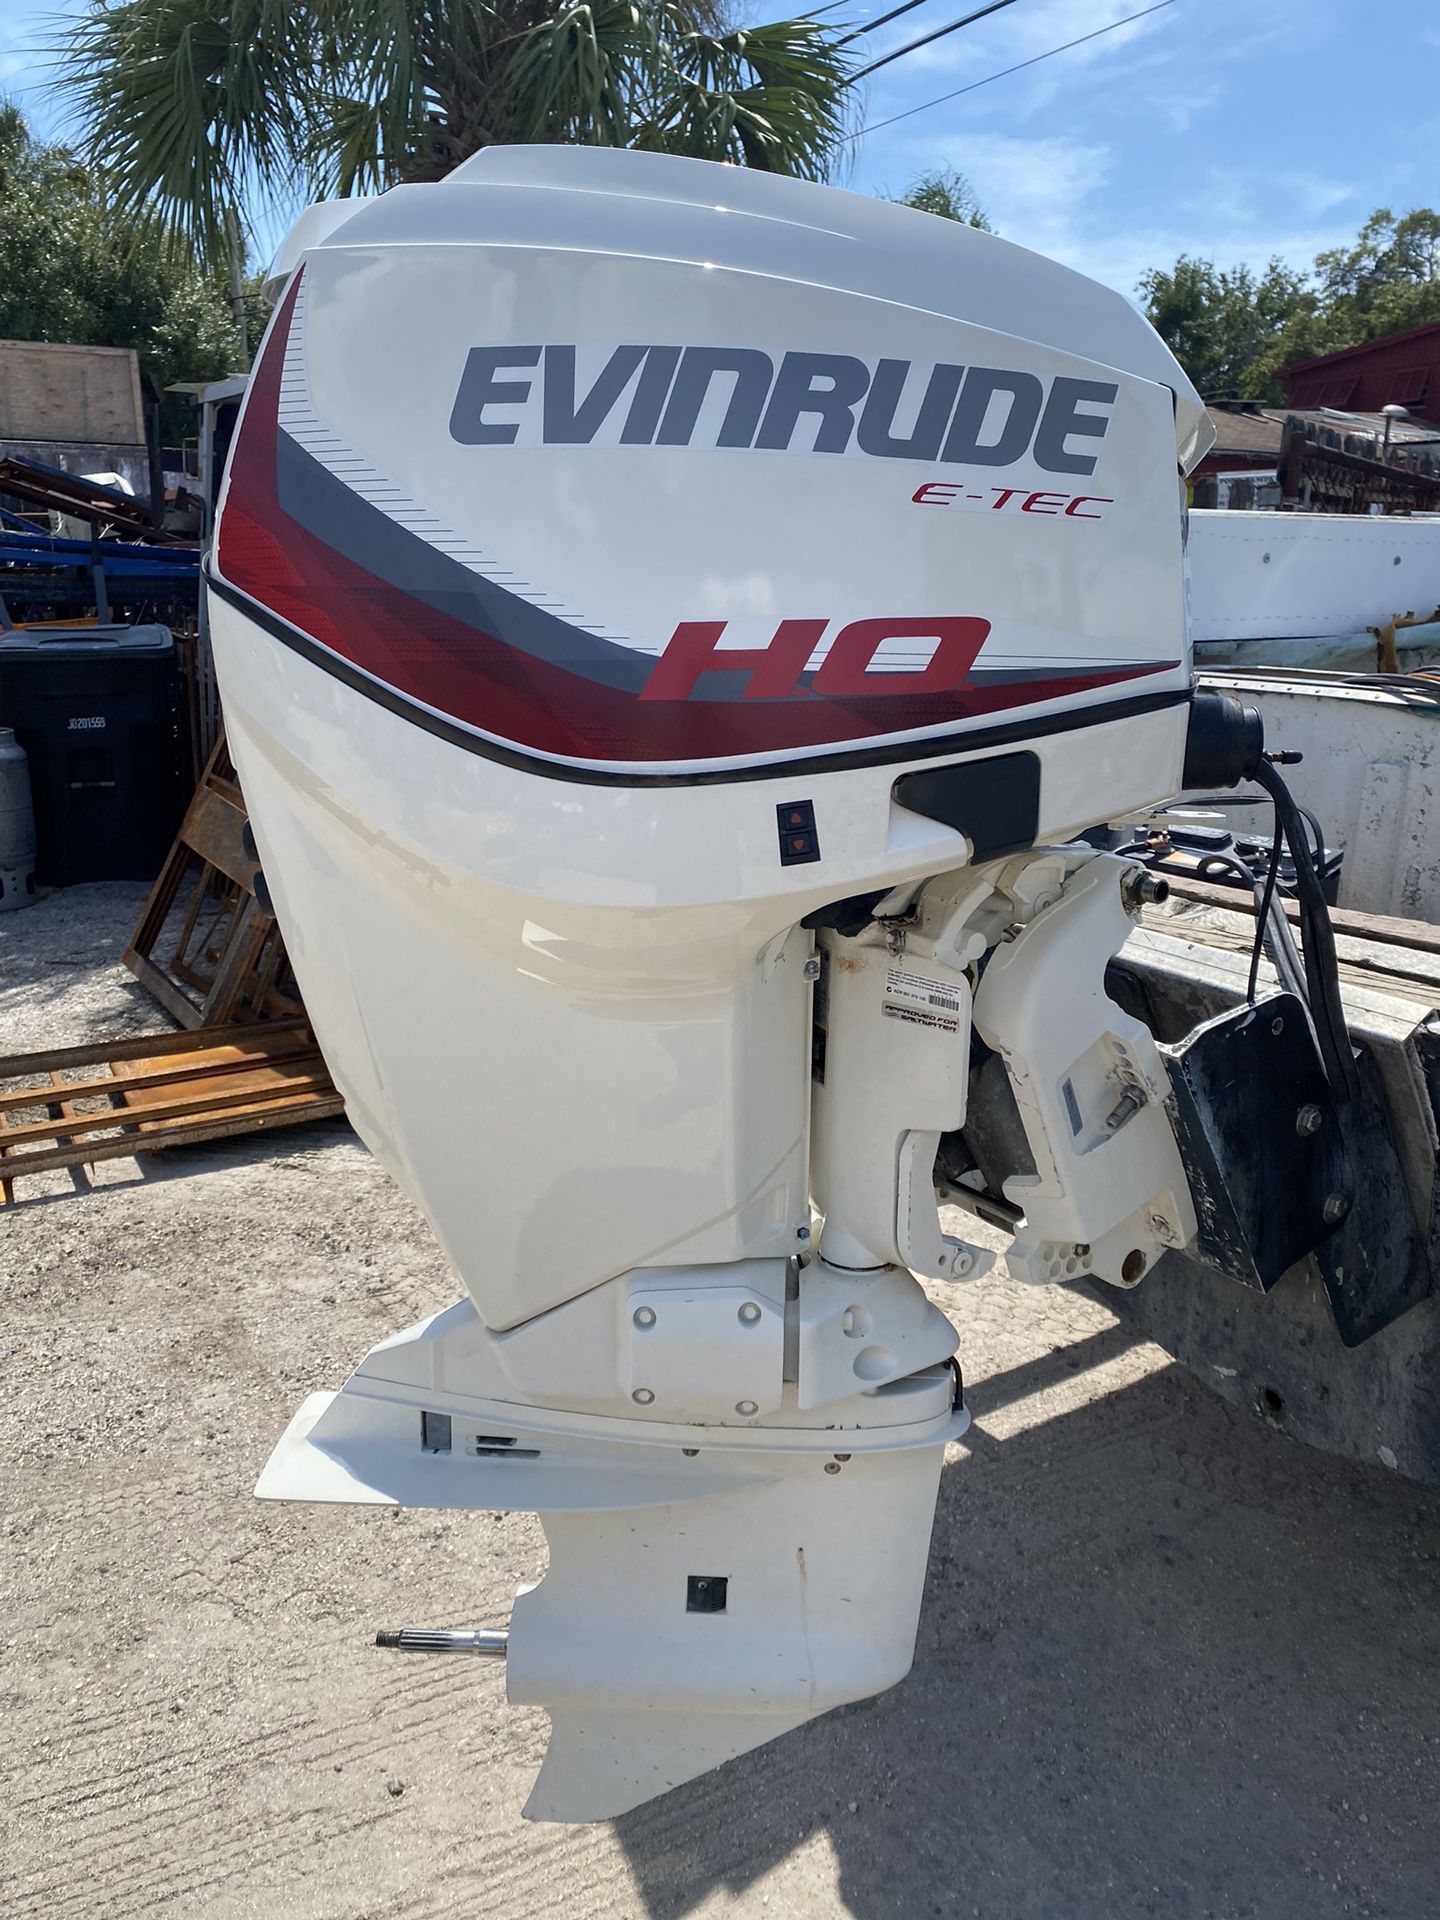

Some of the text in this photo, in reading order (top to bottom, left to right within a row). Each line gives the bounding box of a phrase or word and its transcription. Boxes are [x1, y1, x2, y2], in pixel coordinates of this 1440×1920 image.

[449, 345, 1119, 476] EVINRUDE
[911, 482, 1114, 519] E-TEC
[884, 1005, 957, 1026] APPROVED FOR
[901, 1015, 957, 1032] SALTWATER
